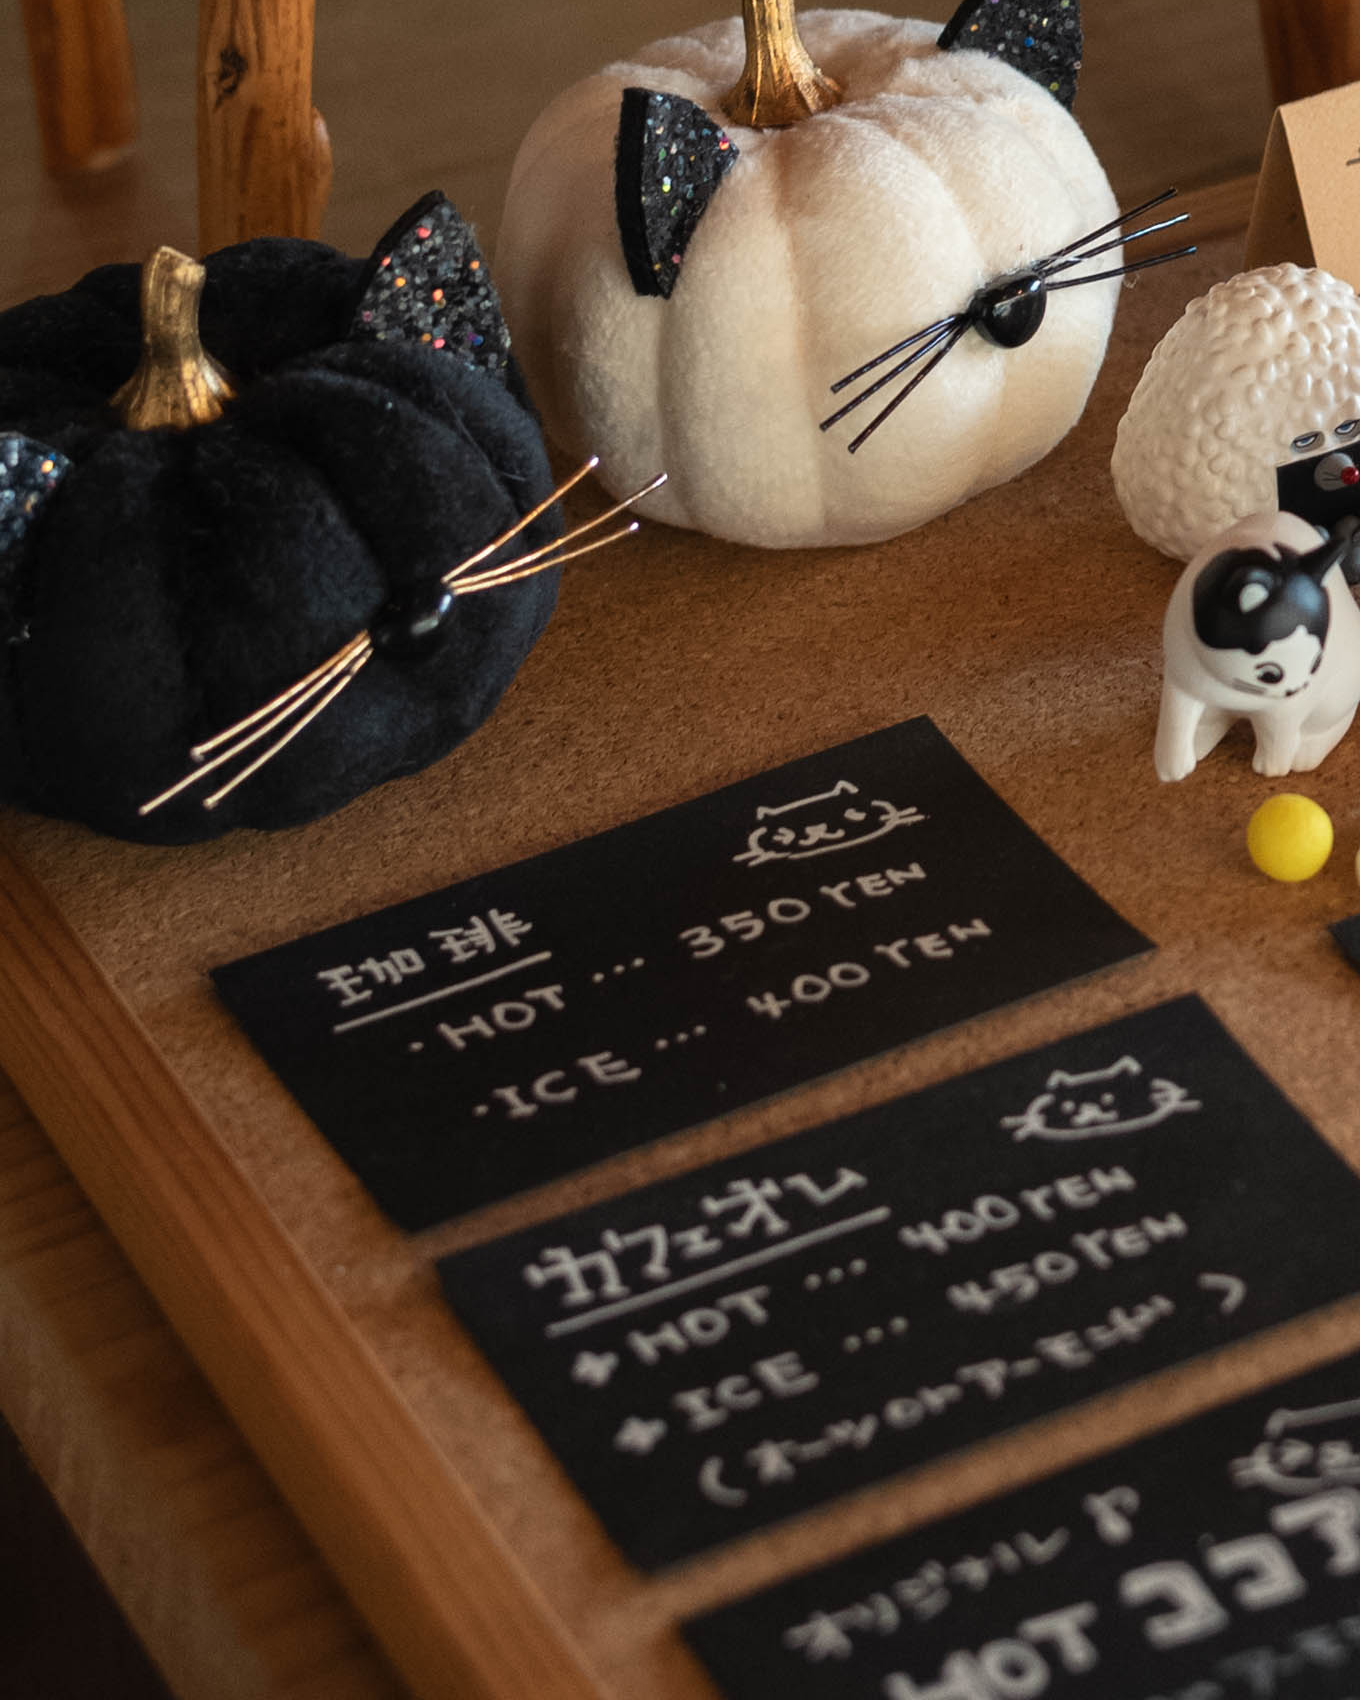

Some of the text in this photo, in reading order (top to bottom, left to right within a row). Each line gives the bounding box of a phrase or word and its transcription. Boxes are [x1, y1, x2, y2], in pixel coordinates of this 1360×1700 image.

[317, 908, 533, 1006] 珈琲
[438, 984, 565, 1049] HOT
[679, 897, 811, 958] 350
[494, 1051, 642, 1117] ICE
[747, 962, 870, 1018] 400
[525, 1168, 867, 1304] カフェオレ
[629, 1286, 767, 1362] HOT
[676, 1352, 818, 1429] ICE
[889, 1603, 1095, 1700] HOT
